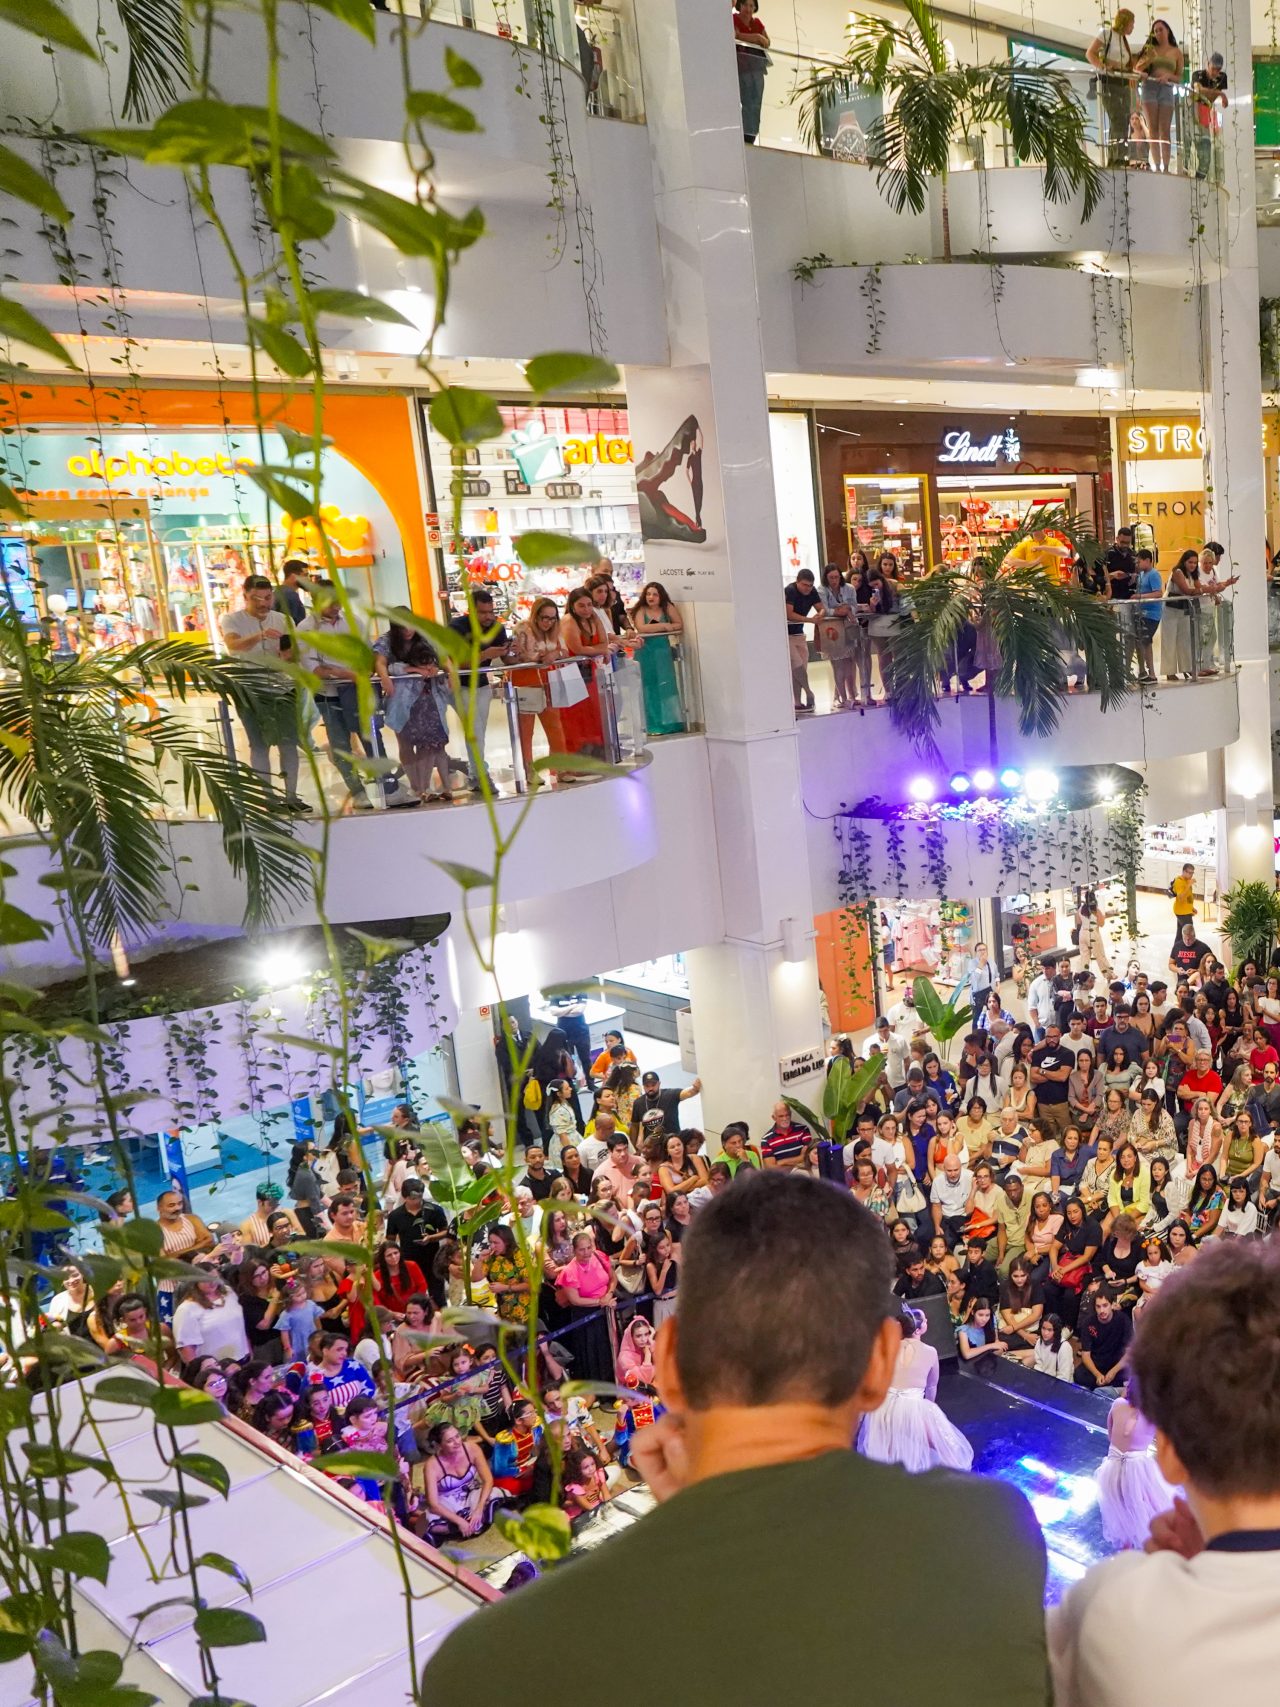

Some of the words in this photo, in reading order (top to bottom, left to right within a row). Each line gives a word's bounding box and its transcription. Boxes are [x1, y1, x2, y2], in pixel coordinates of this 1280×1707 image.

[939, 431, 1003, 462] Lindt
[67, 448, 256, 482] alphabeto
[1128, 500, 1202, 517] STROK
[659, 568, 684, 576] LACOSTE
